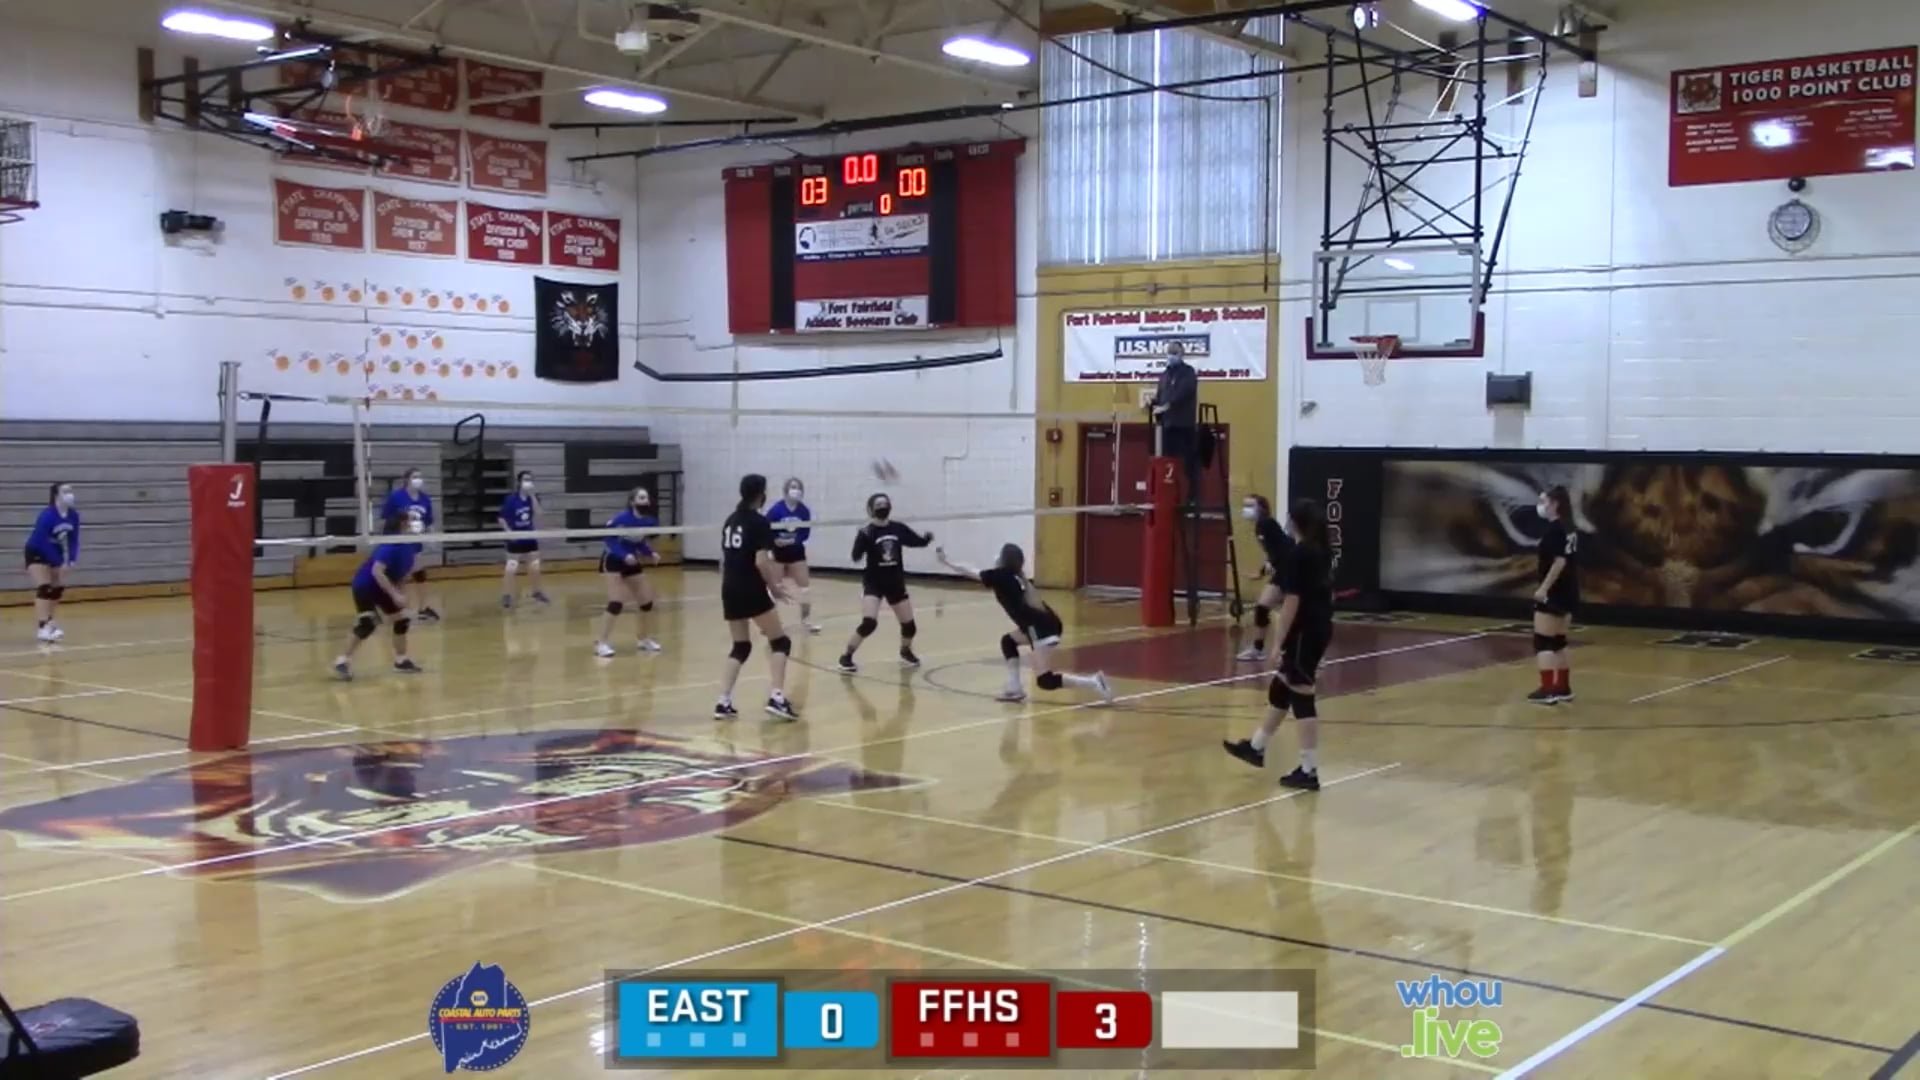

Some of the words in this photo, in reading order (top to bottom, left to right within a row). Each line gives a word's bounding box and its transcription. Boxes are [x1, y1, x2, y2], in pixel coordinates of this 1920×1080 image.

[1730, 67, 1784, 86] TIGER
[1790, 56, 1913, 80] BASKETBALL
[1733, 84, 1782, 103] 1000
[1789, 79, 1852, 98] POINT
[1858, 74, 1912, 91] CLUB
[802, 177, 828, 205] 03
[899, 168, 926, 196] 00
[280, 190, 306, 215] STATE
[314, 190, 360, 222] CHAMPIONS
[377, 200, 402, 216] STATE
[410, 200, 455, 224] CHAMPIONS
[880, 193, 892, 214] 0
[470, 212, 494, 230] STATE
[498, 212, 541, 236] CHAMPIONS
[486, 224, 518, 236] DIVISION
[550, 218, 572, 236] STATE
[578, 218, 618, 244] CHAMPIONS
[565, 234, 596, 246] DIVISION
[828, 302, 848, 314] Fort
[852, 300, 893, 313] Fairfield
[1066, 314, 1089, 326] Fort
[1093, 312, 1140, 326] Fairfield
[1145, 311, 1186, 324] Middle
[1190, 309, 1218, 324] High
[1222, 307, 1265, 320] School
[805, 318, 842, 328] Athletic
[846, 316, 890, 328] Boosters
[894, 314, 918, 325] Club
[724, 525, 743, 548] 16
